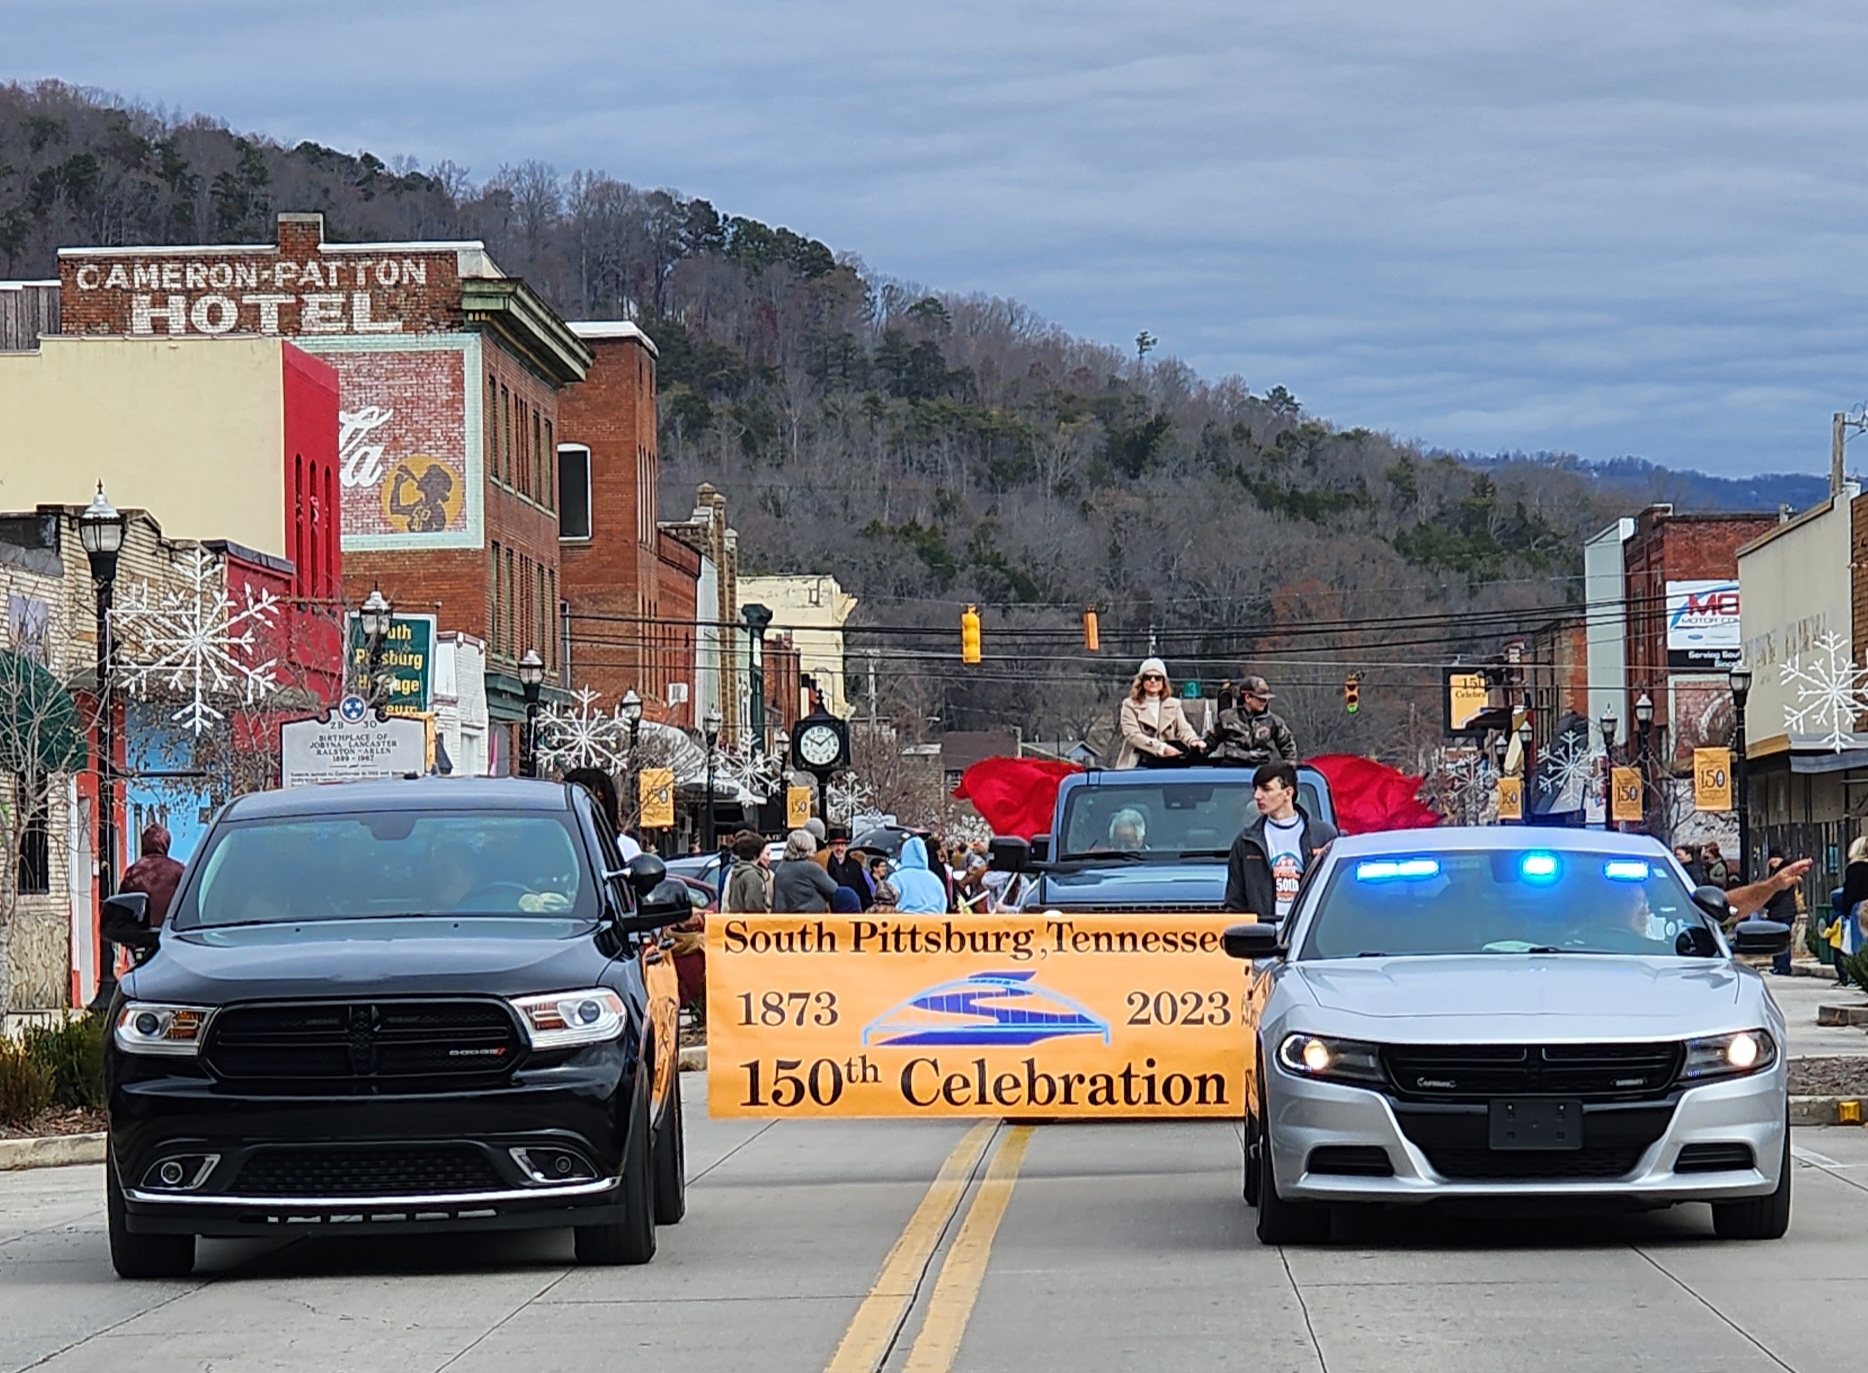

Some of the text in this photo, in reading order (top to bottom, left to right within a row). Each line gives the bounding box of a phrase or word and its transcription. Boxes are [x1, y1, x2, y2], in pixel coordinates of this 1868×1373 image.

[76, 259, 426, 290] CAMERON-PATTON
[131, 293, 403, 334] HOTEL
[1688, 650, 1721, 662] Serving
[319, 734, 369, 742] BIRTHPLACE
[330, 721, 344, 730] 2B
[348, 740, 397, 748] LANCASTER
[1701, 769, 1725, 788] 150
[1617, 785, 1638, 802] 150
[724, 920, 839, 954] South
[1046, 920, 1226, 954] Tennesse
[736, 991, 839, 1027] 1873
[1126, 991, 1232, 1026] 2023
[739, 1054, 1230, 1108] 150th Celebration
